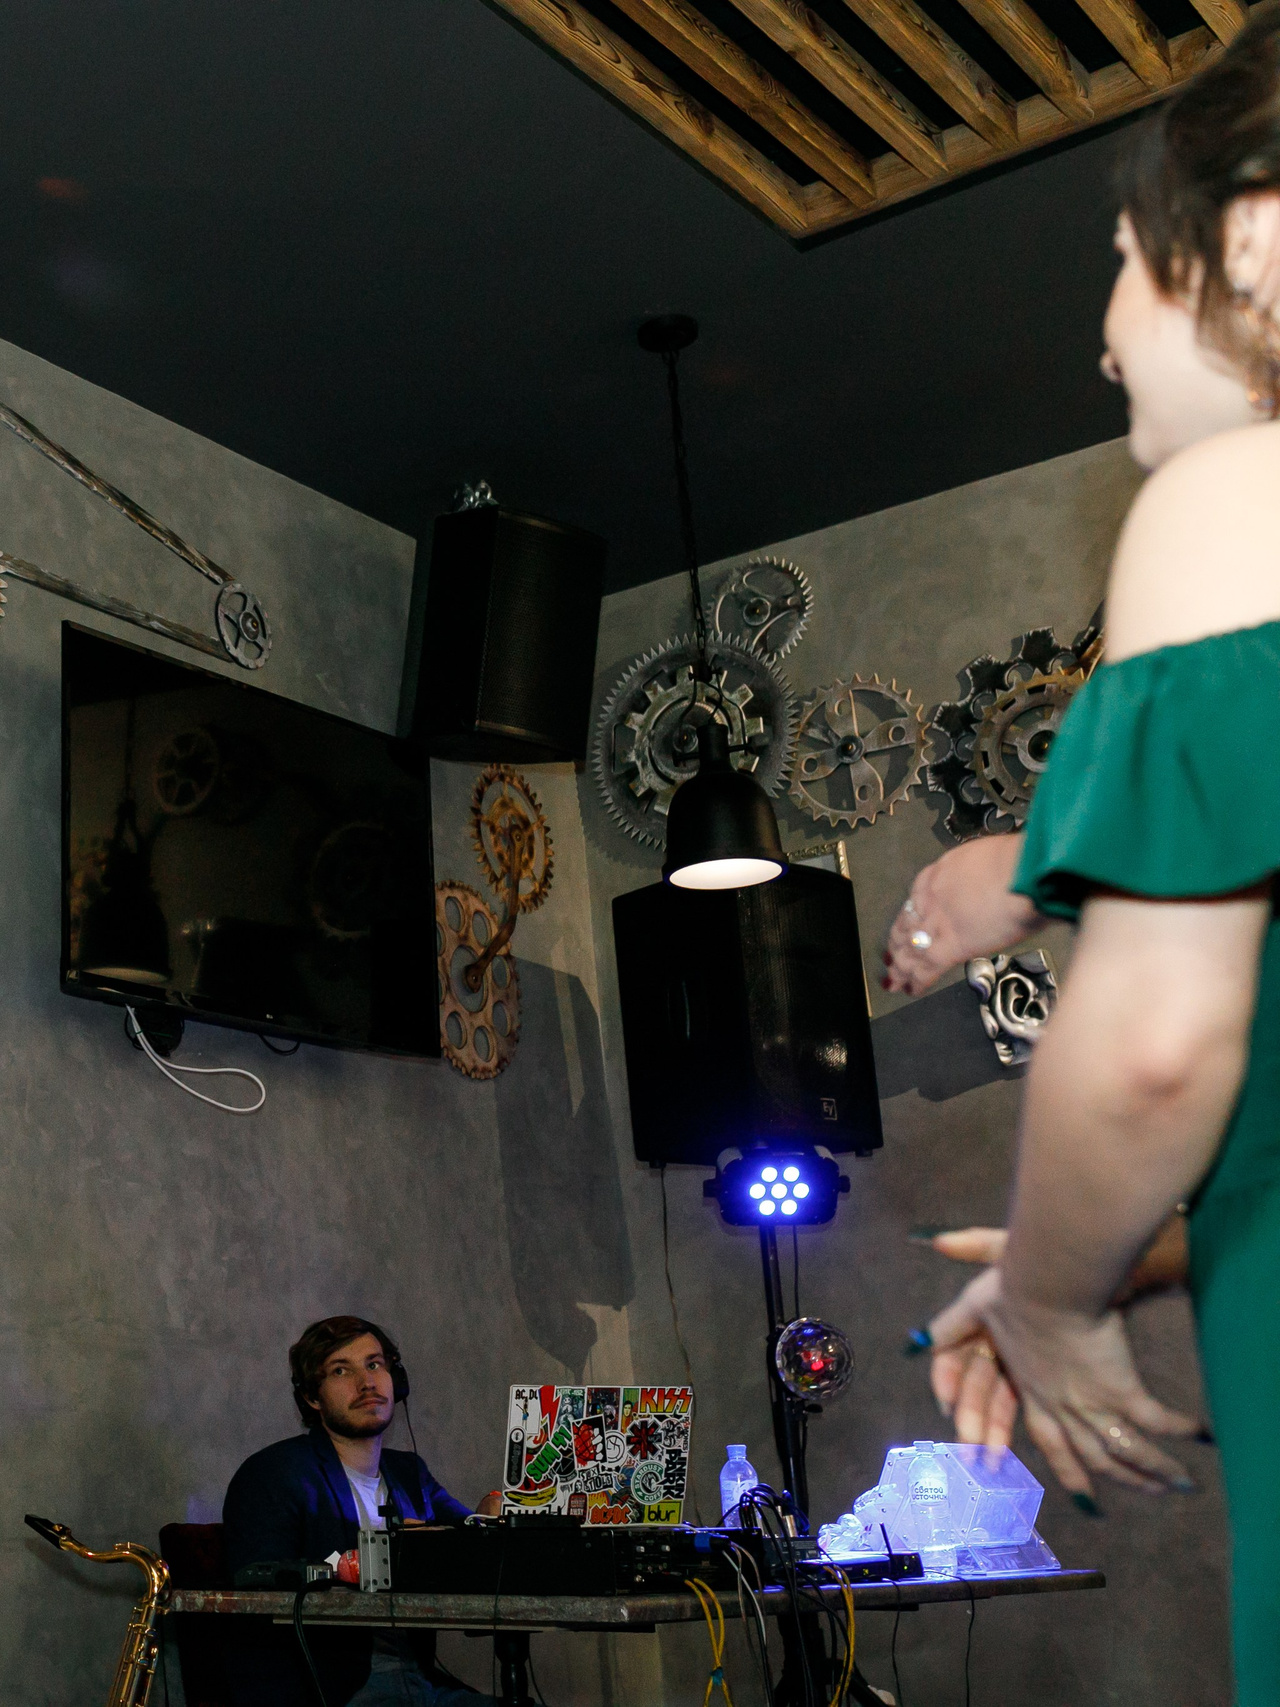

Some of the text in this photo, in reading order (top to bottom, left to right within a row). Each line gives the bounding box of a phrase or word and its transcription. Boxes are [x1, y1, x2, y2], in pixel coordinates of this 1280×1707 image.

[640, 1387, 692, 1413] KISS
[526, 1442, 561, 1481] SUM
[551, 1426, 572, 1448] 41
[634, 1464, 662, 1489] STARDUST
[660, 1449, 679, 1498] PARK
[648, 1505, 675, 1521] blur
